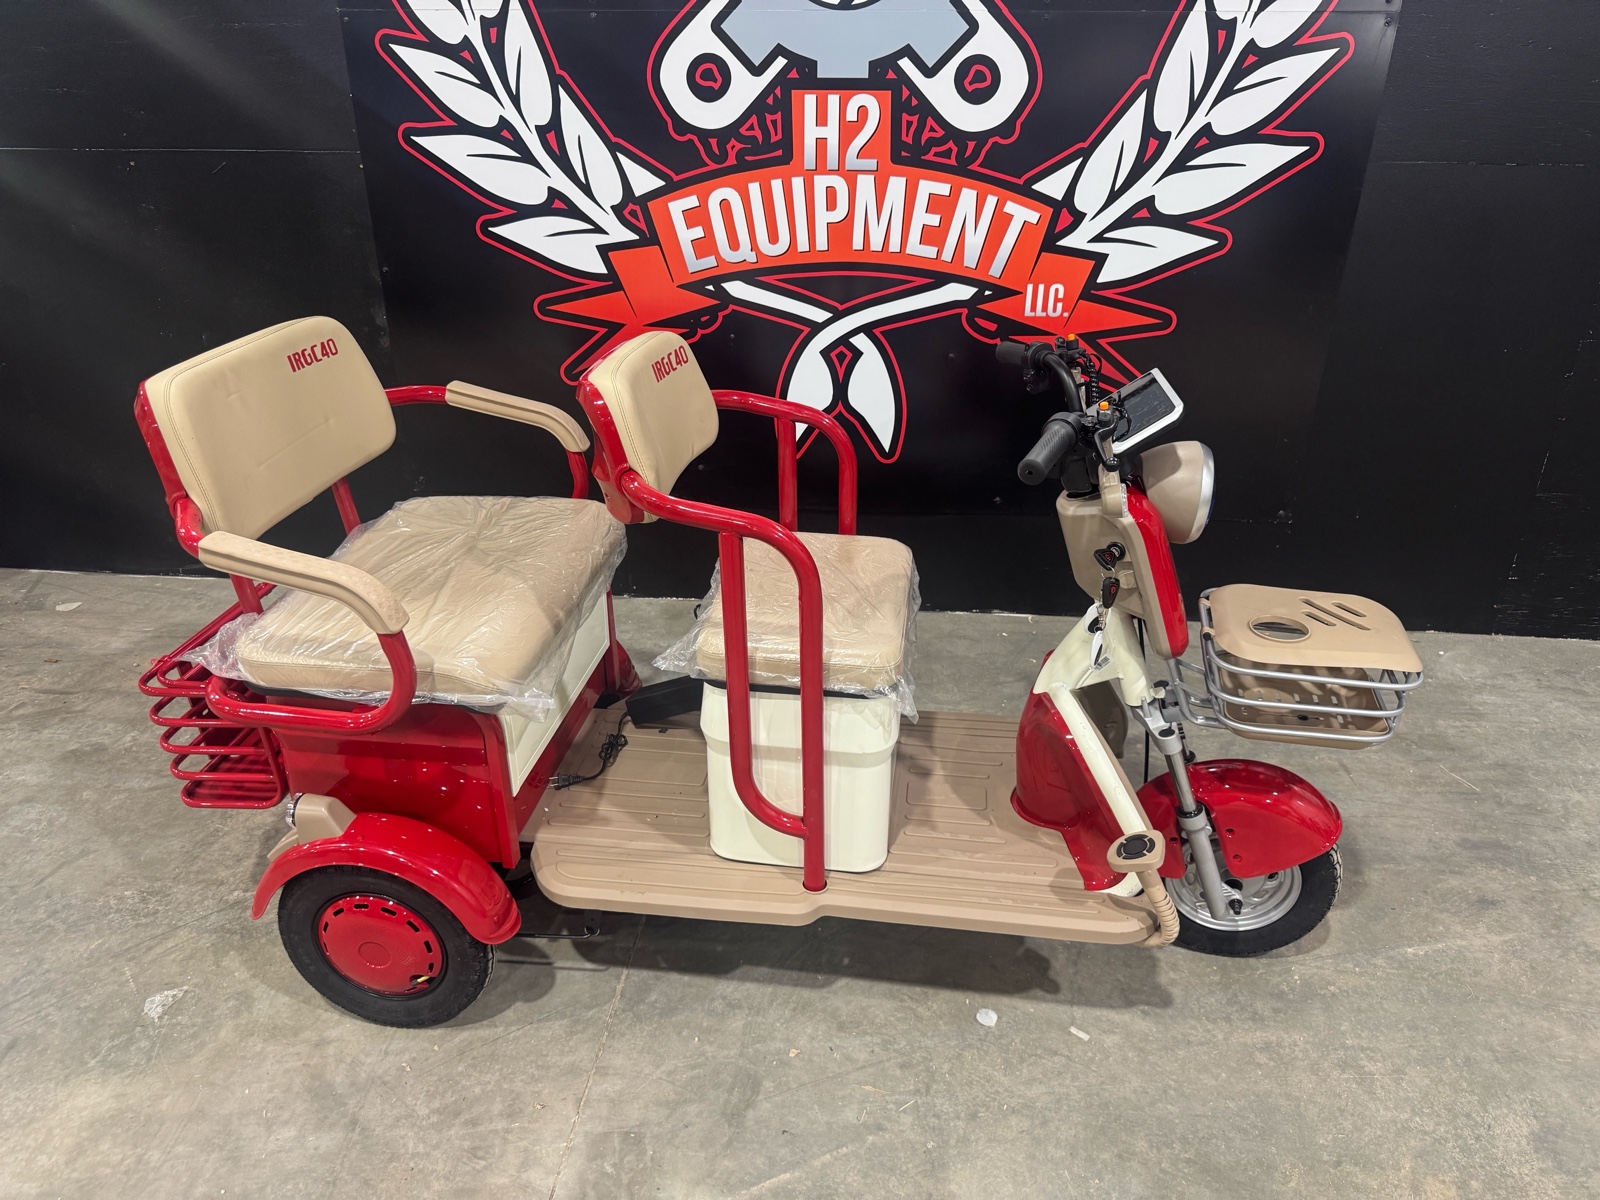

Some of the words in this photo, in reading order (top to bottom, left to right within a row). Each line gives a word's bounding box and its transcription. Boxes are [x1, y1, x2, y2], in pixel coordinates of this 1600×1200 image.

[803, 93, 881, 171] H2
[667, 174, 1041, 279] EQUIPMENT
[1024, 283, 1069, 318] LLC.
[286, 338, 339, 373] IRGC40
[651, 344, 689, 383] IRGC40
